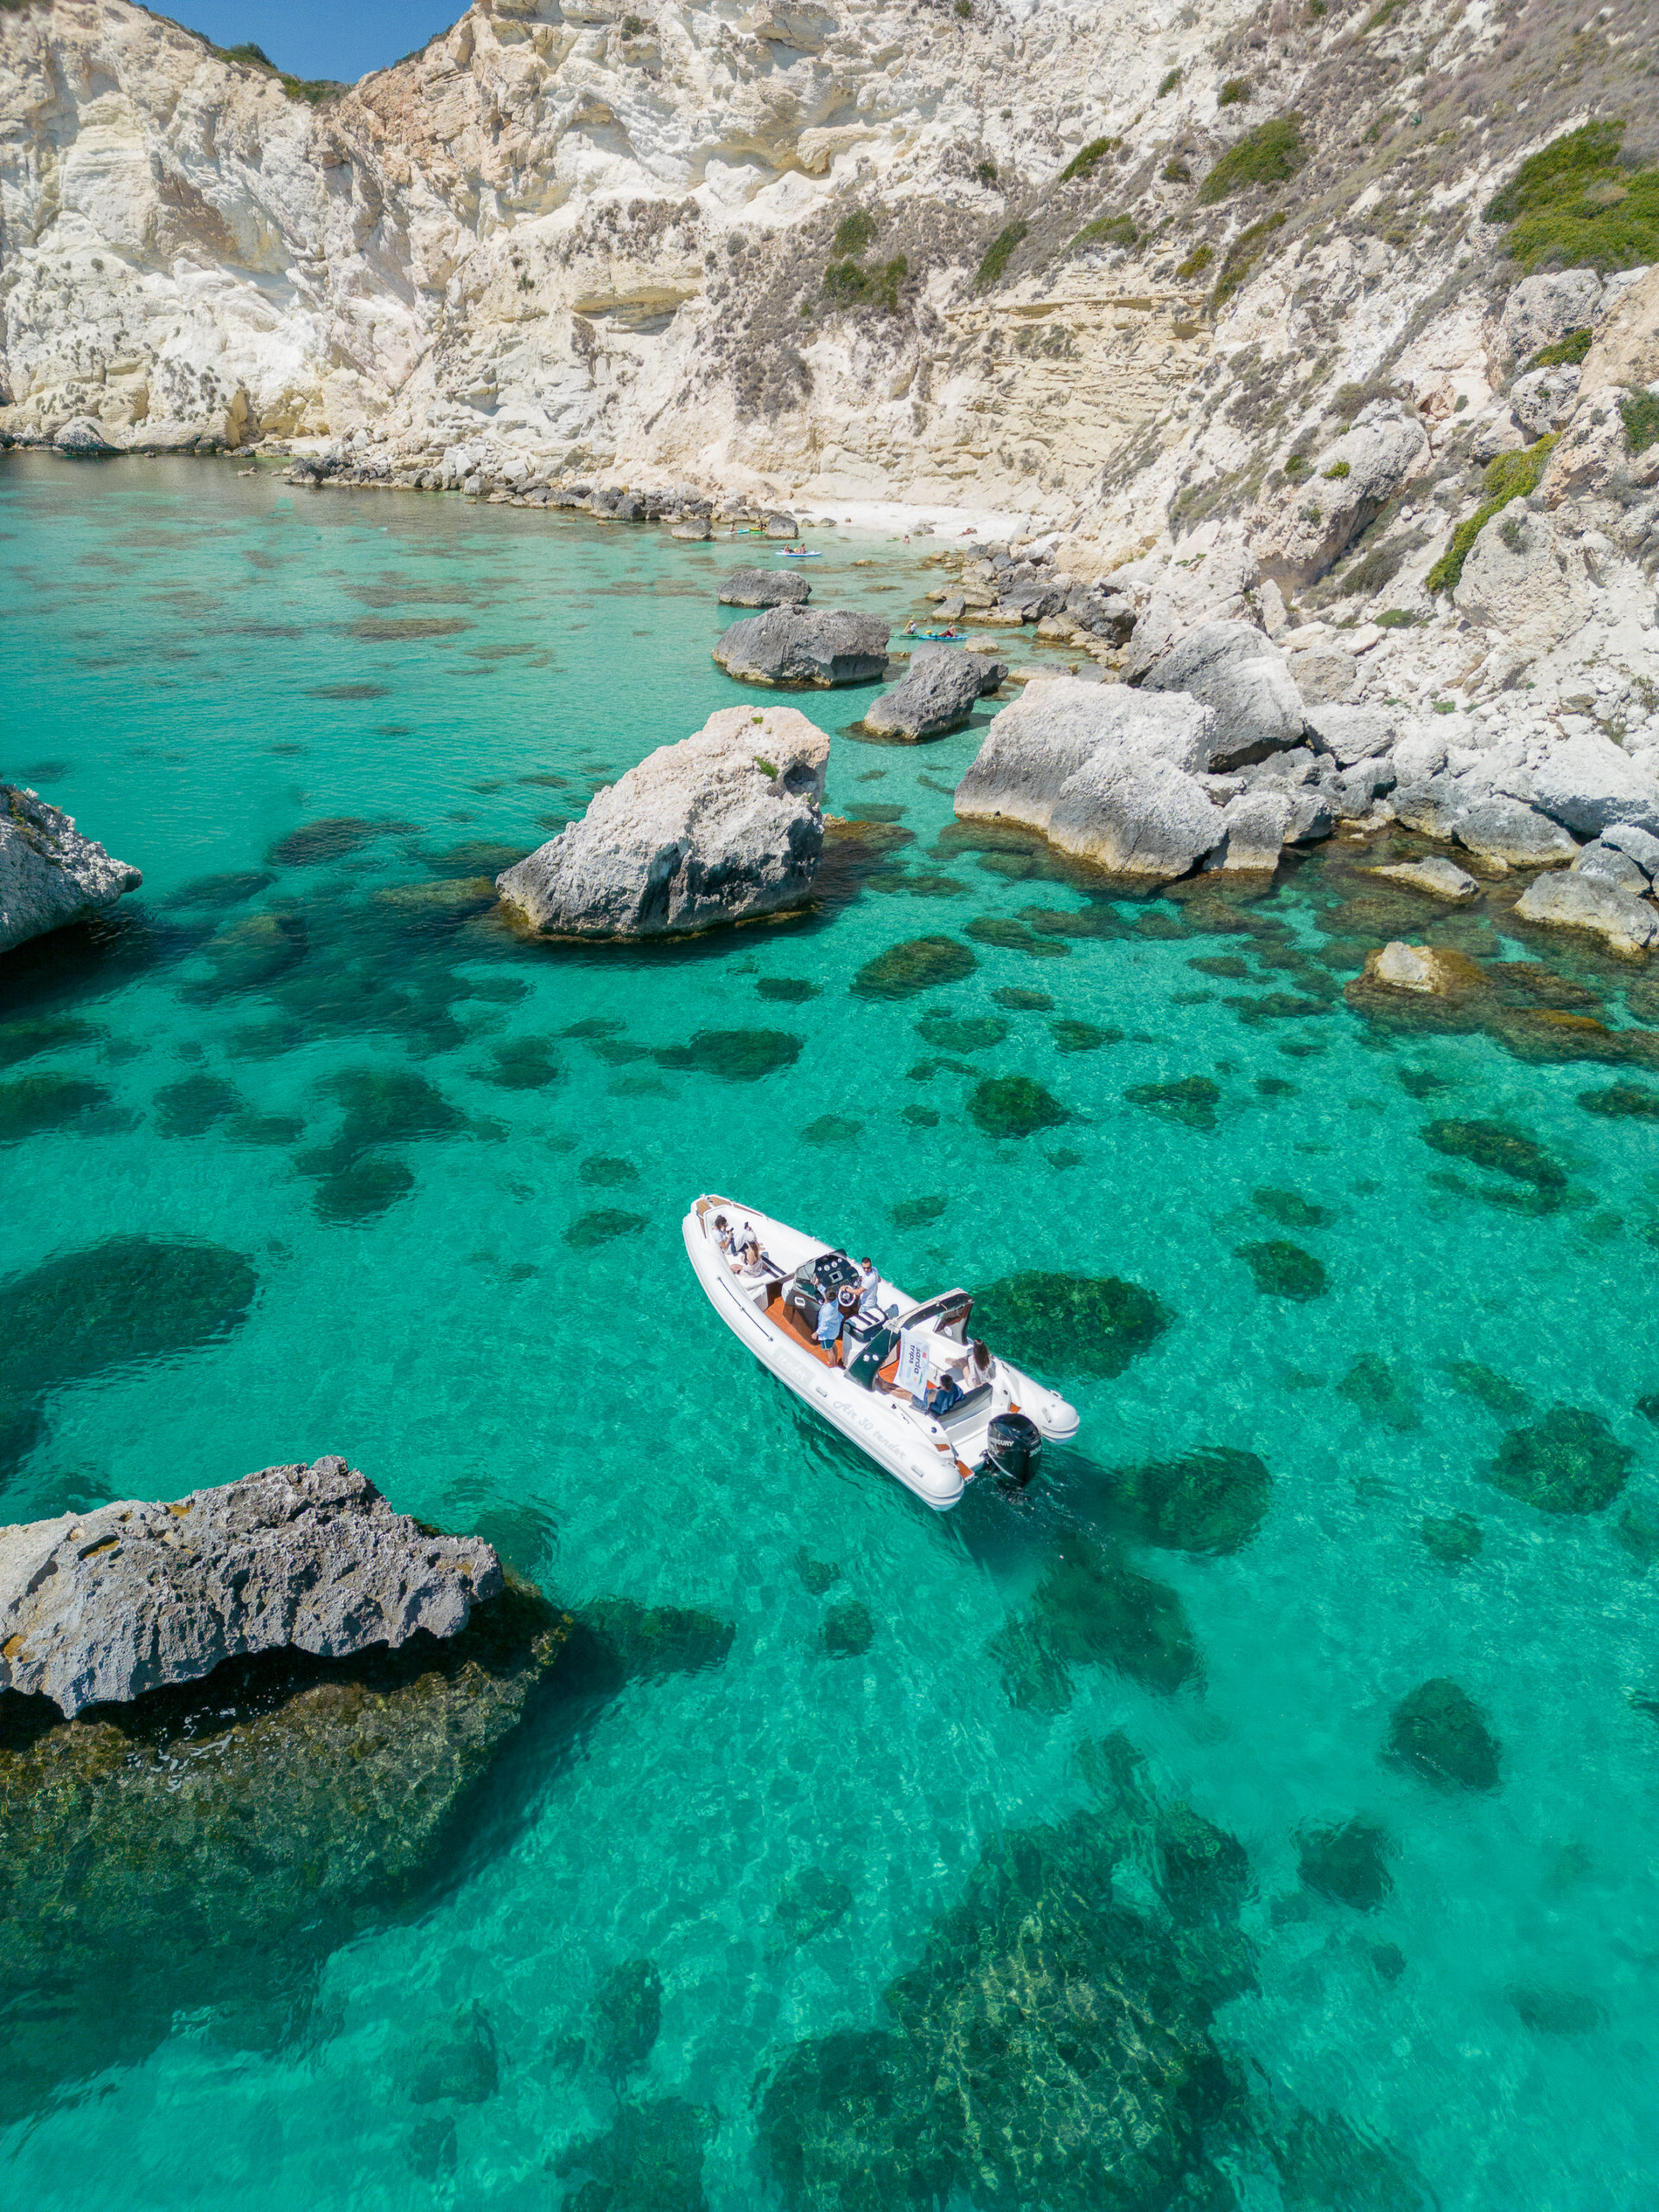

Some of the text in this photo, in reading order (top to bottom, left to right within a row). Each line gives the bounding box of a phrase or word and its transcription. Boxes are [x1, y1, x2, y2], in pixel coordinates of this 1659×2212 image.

[832, 1401, 906, 1460] Air 30 tender
